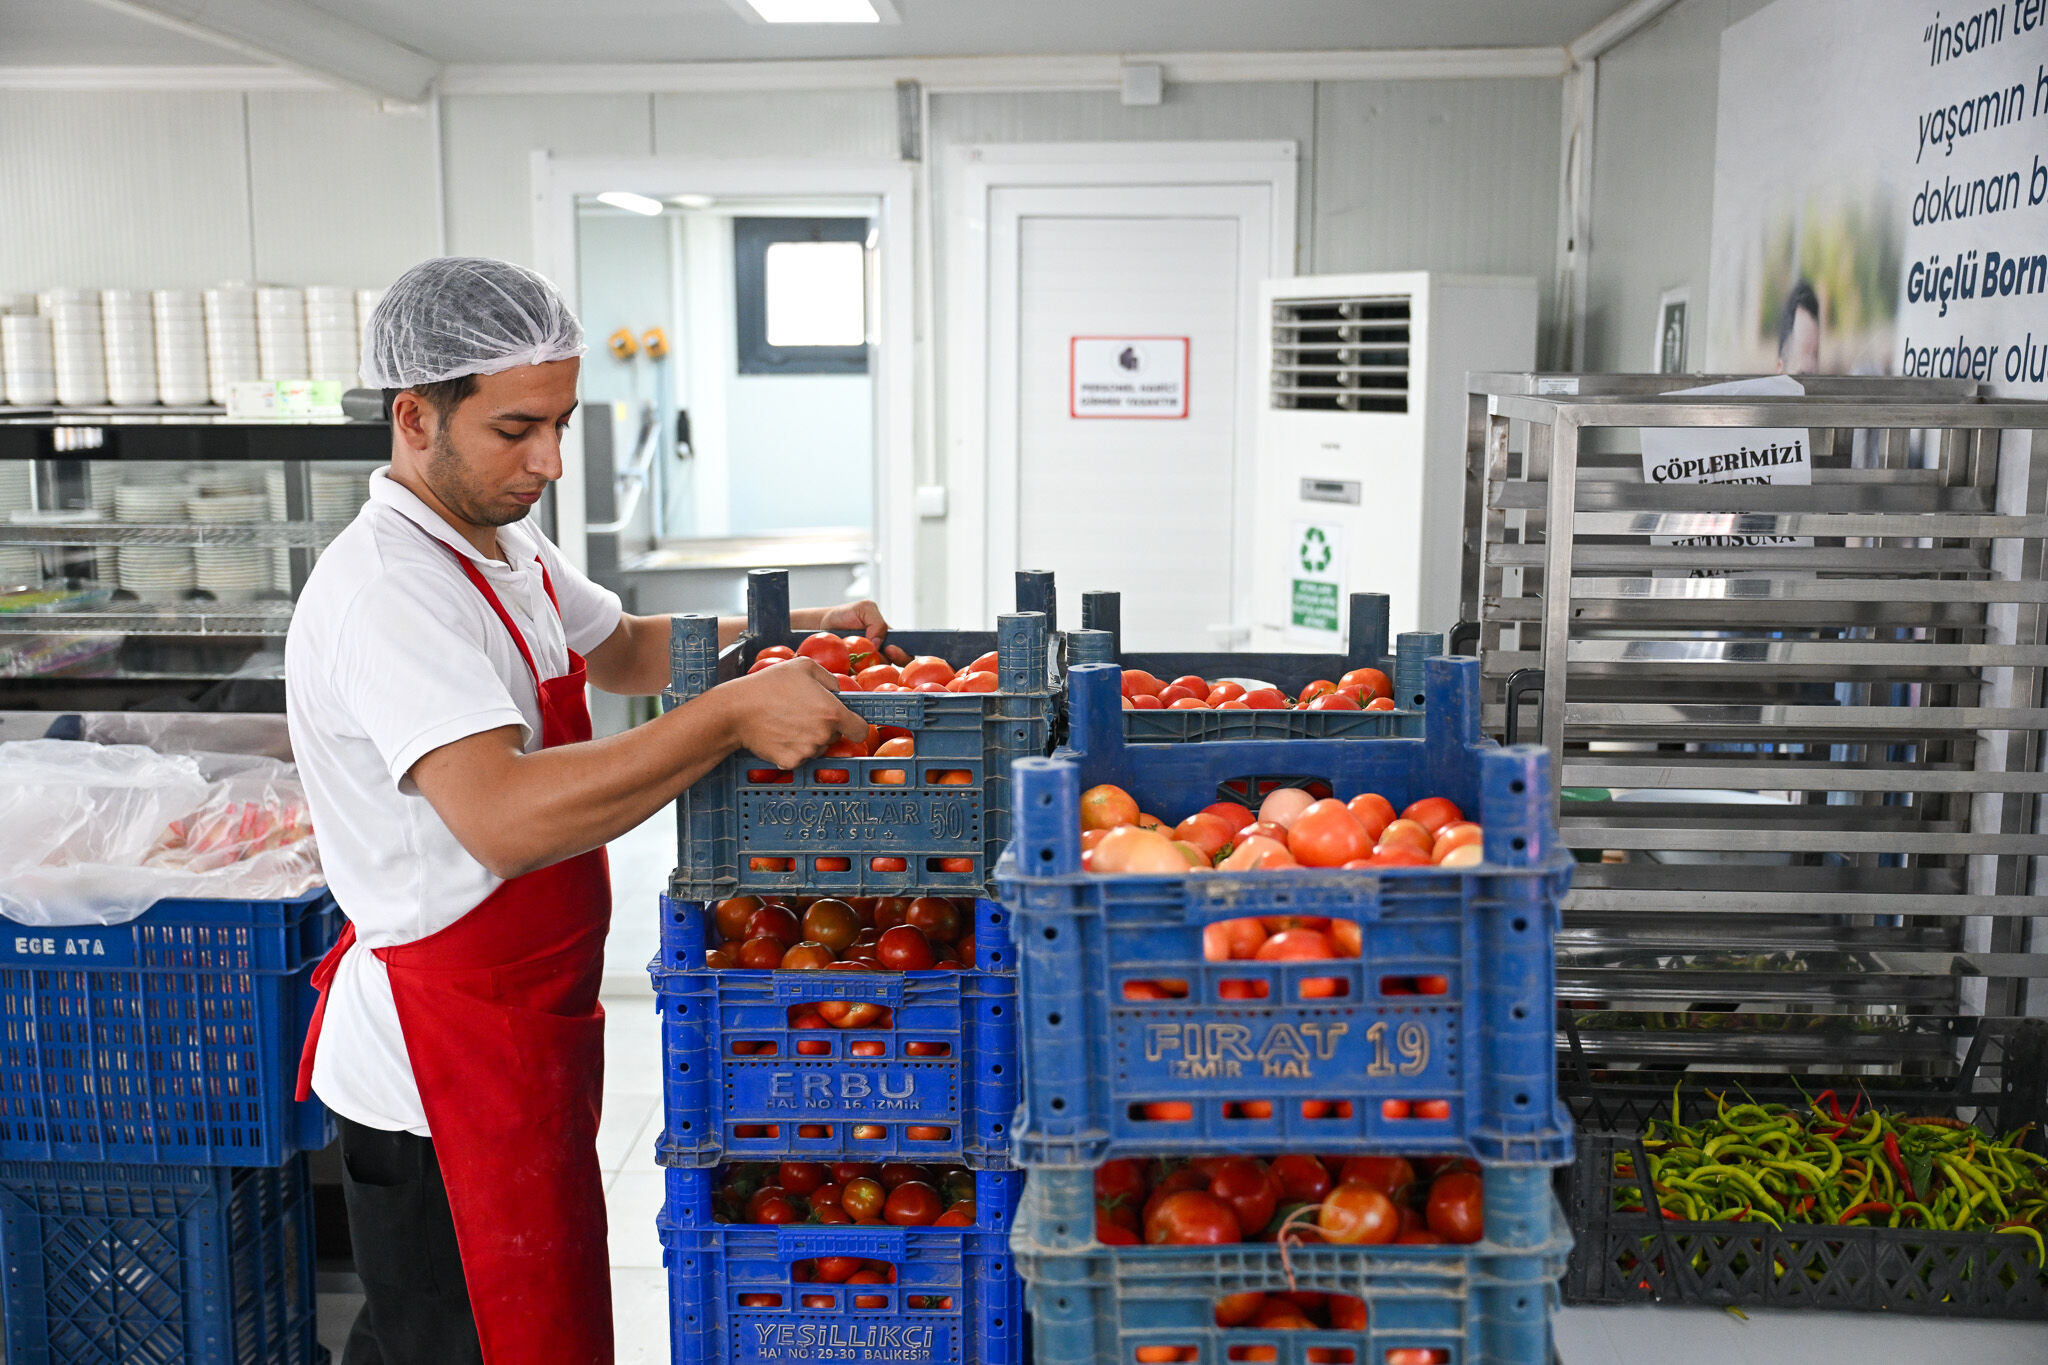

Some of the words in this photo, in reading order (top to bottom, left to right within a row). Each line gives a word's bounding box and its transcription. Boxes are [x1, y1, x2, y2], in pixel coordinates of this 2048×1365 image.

[1916, 83, 2025, 164] yaşamın
[1912, 171, 2020, 226] dokunan
[1907, 249, 1978, 318] Güçlü
[1903, 335, 1999, 382] beraber
[1652, 440, 1803, 483] ÇÖPLERİMİZİ
[758, 801, 920, 828] KOÇAKLAR
[929, 801, 964, 839] 50
[15, 937, 55, 954] EGE
[65, 938, 105, 955] ATA
[1145, 1022, 1349, 1061] FIRAT
[1365, 1021, 1430, 1077] 19
[770, 1072, 915, 1099] ERBU
